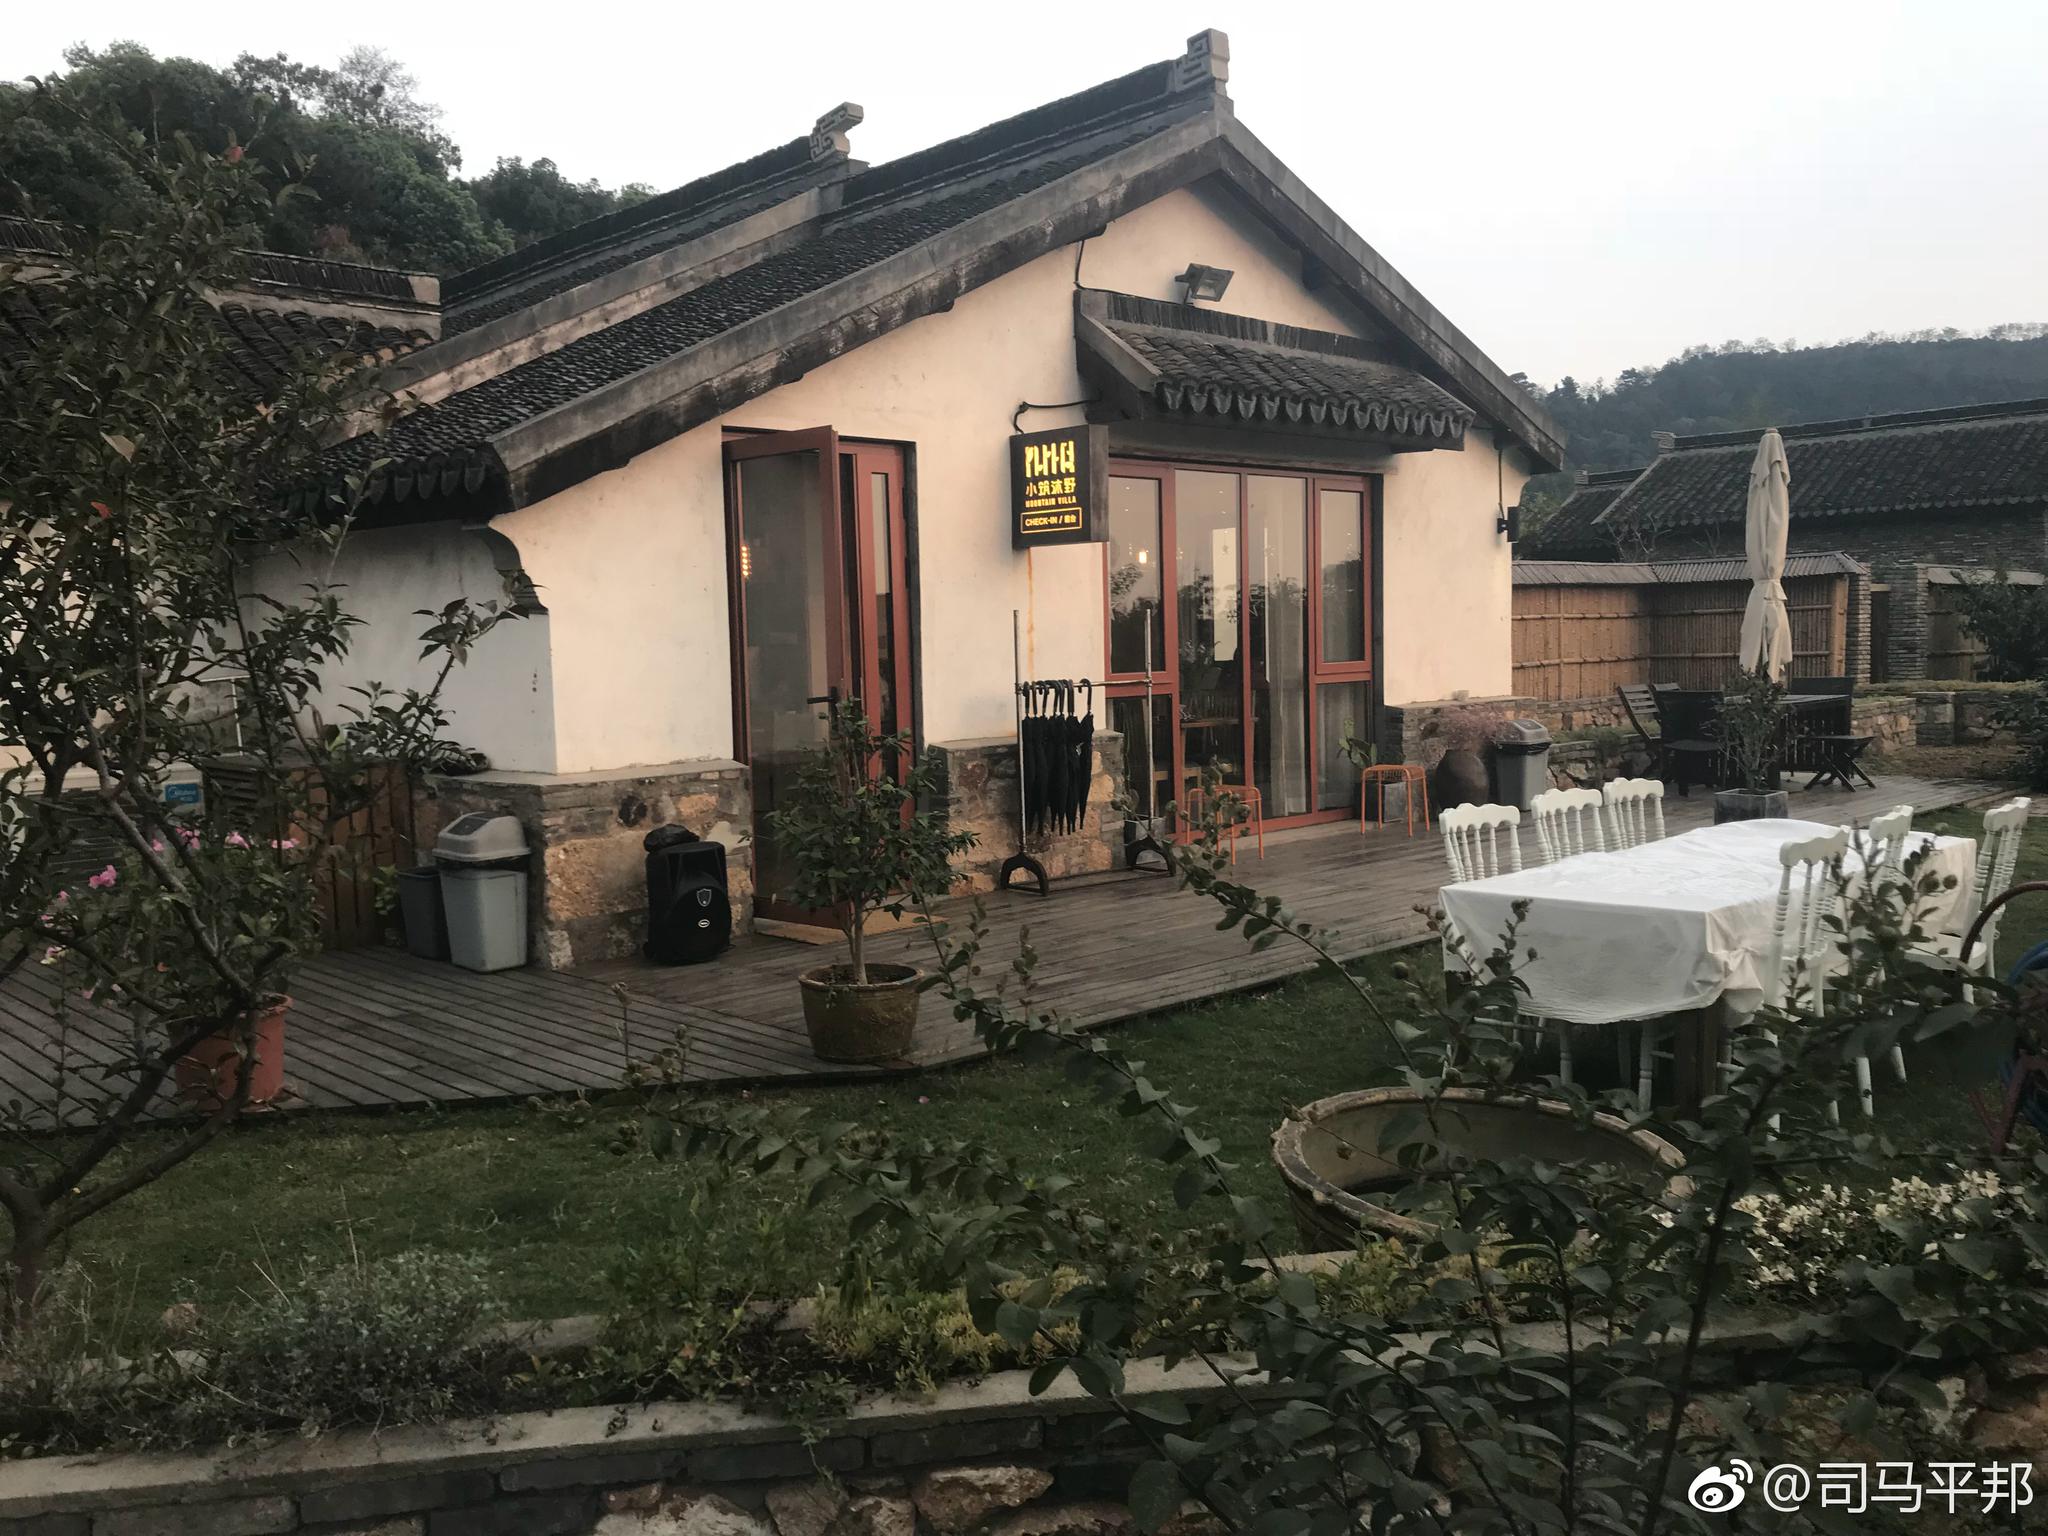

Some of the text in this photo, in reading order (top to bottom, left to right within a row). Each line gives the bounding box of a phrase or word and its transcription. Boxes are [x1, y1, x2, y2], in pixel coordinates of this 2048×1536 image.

[1025, 496, 1077, 508] MOUNTAIN VILLA
[1025, 516, 1058, 527] CHECK-IN
